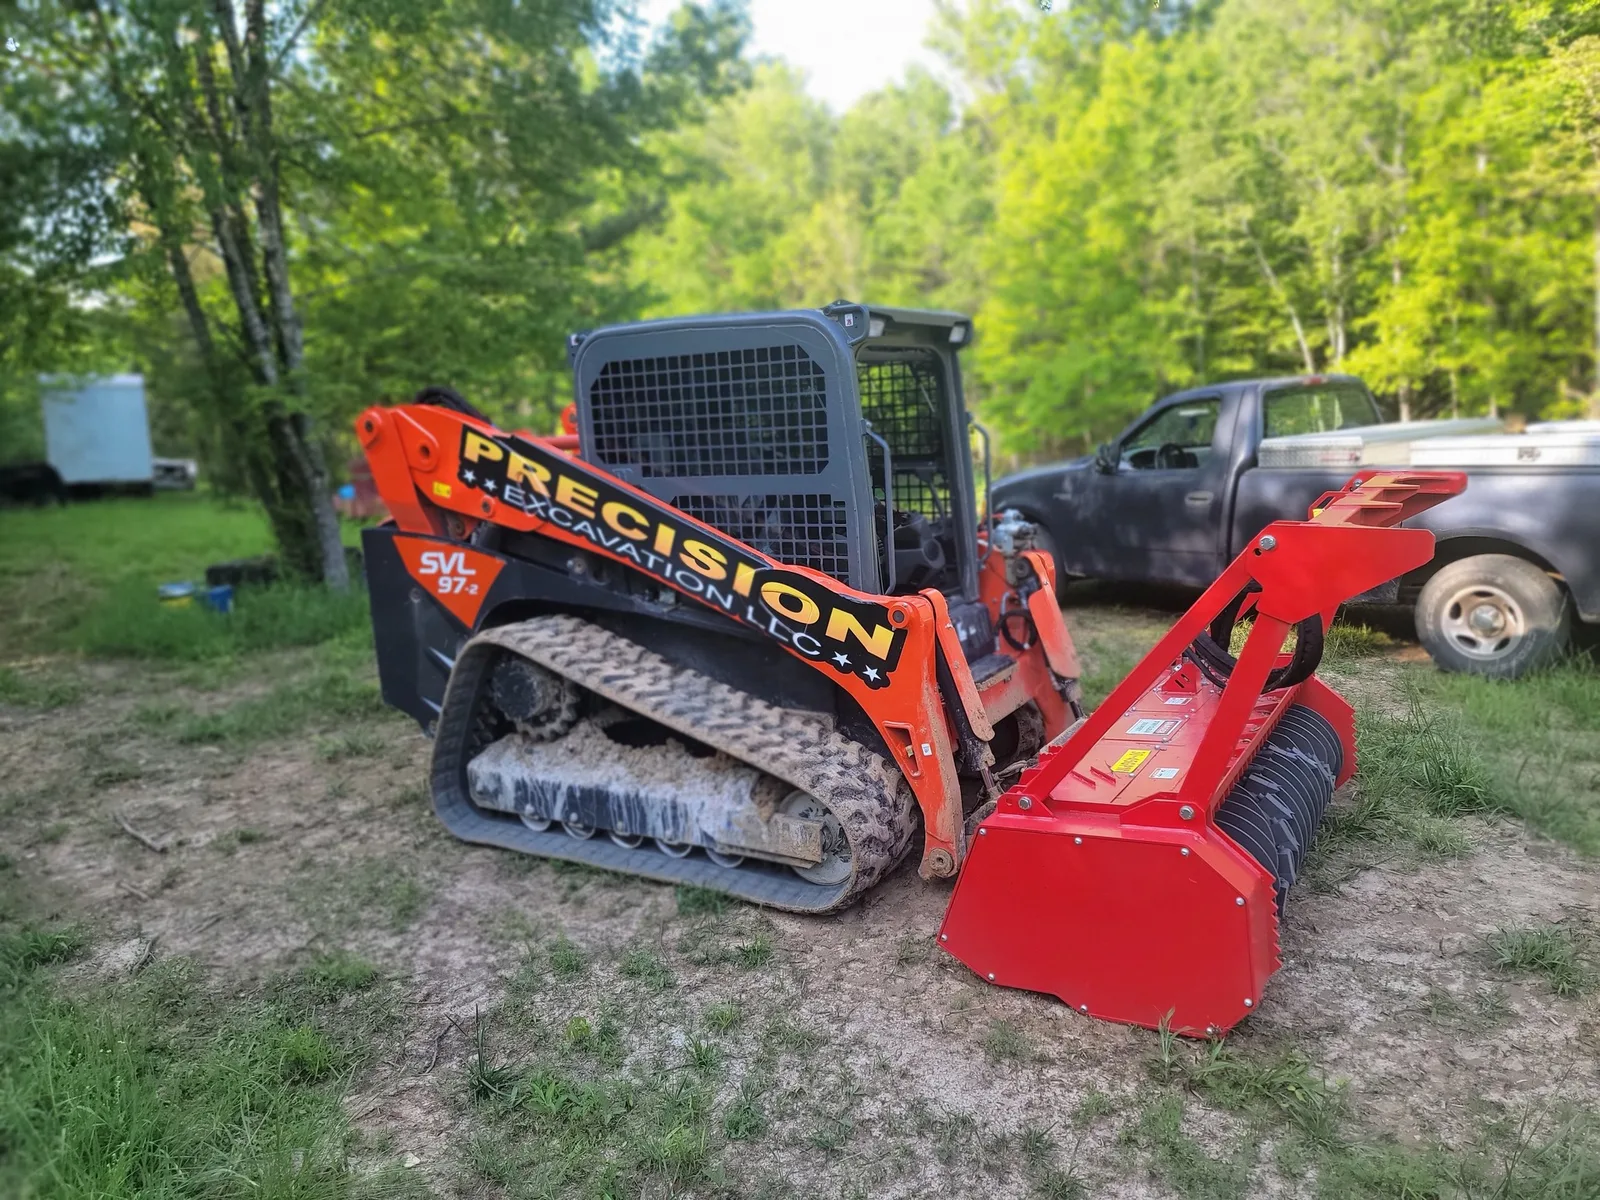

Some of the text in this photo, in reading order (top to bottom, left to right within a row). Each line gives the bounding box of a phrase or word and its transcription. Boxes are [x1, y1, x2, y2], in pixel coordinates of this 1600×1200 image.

[418, 551, 477, 575] SVL
[463, 431, 895, 661] PRECISION
[503, 484, 822, 656] EXCAVATION LLC
